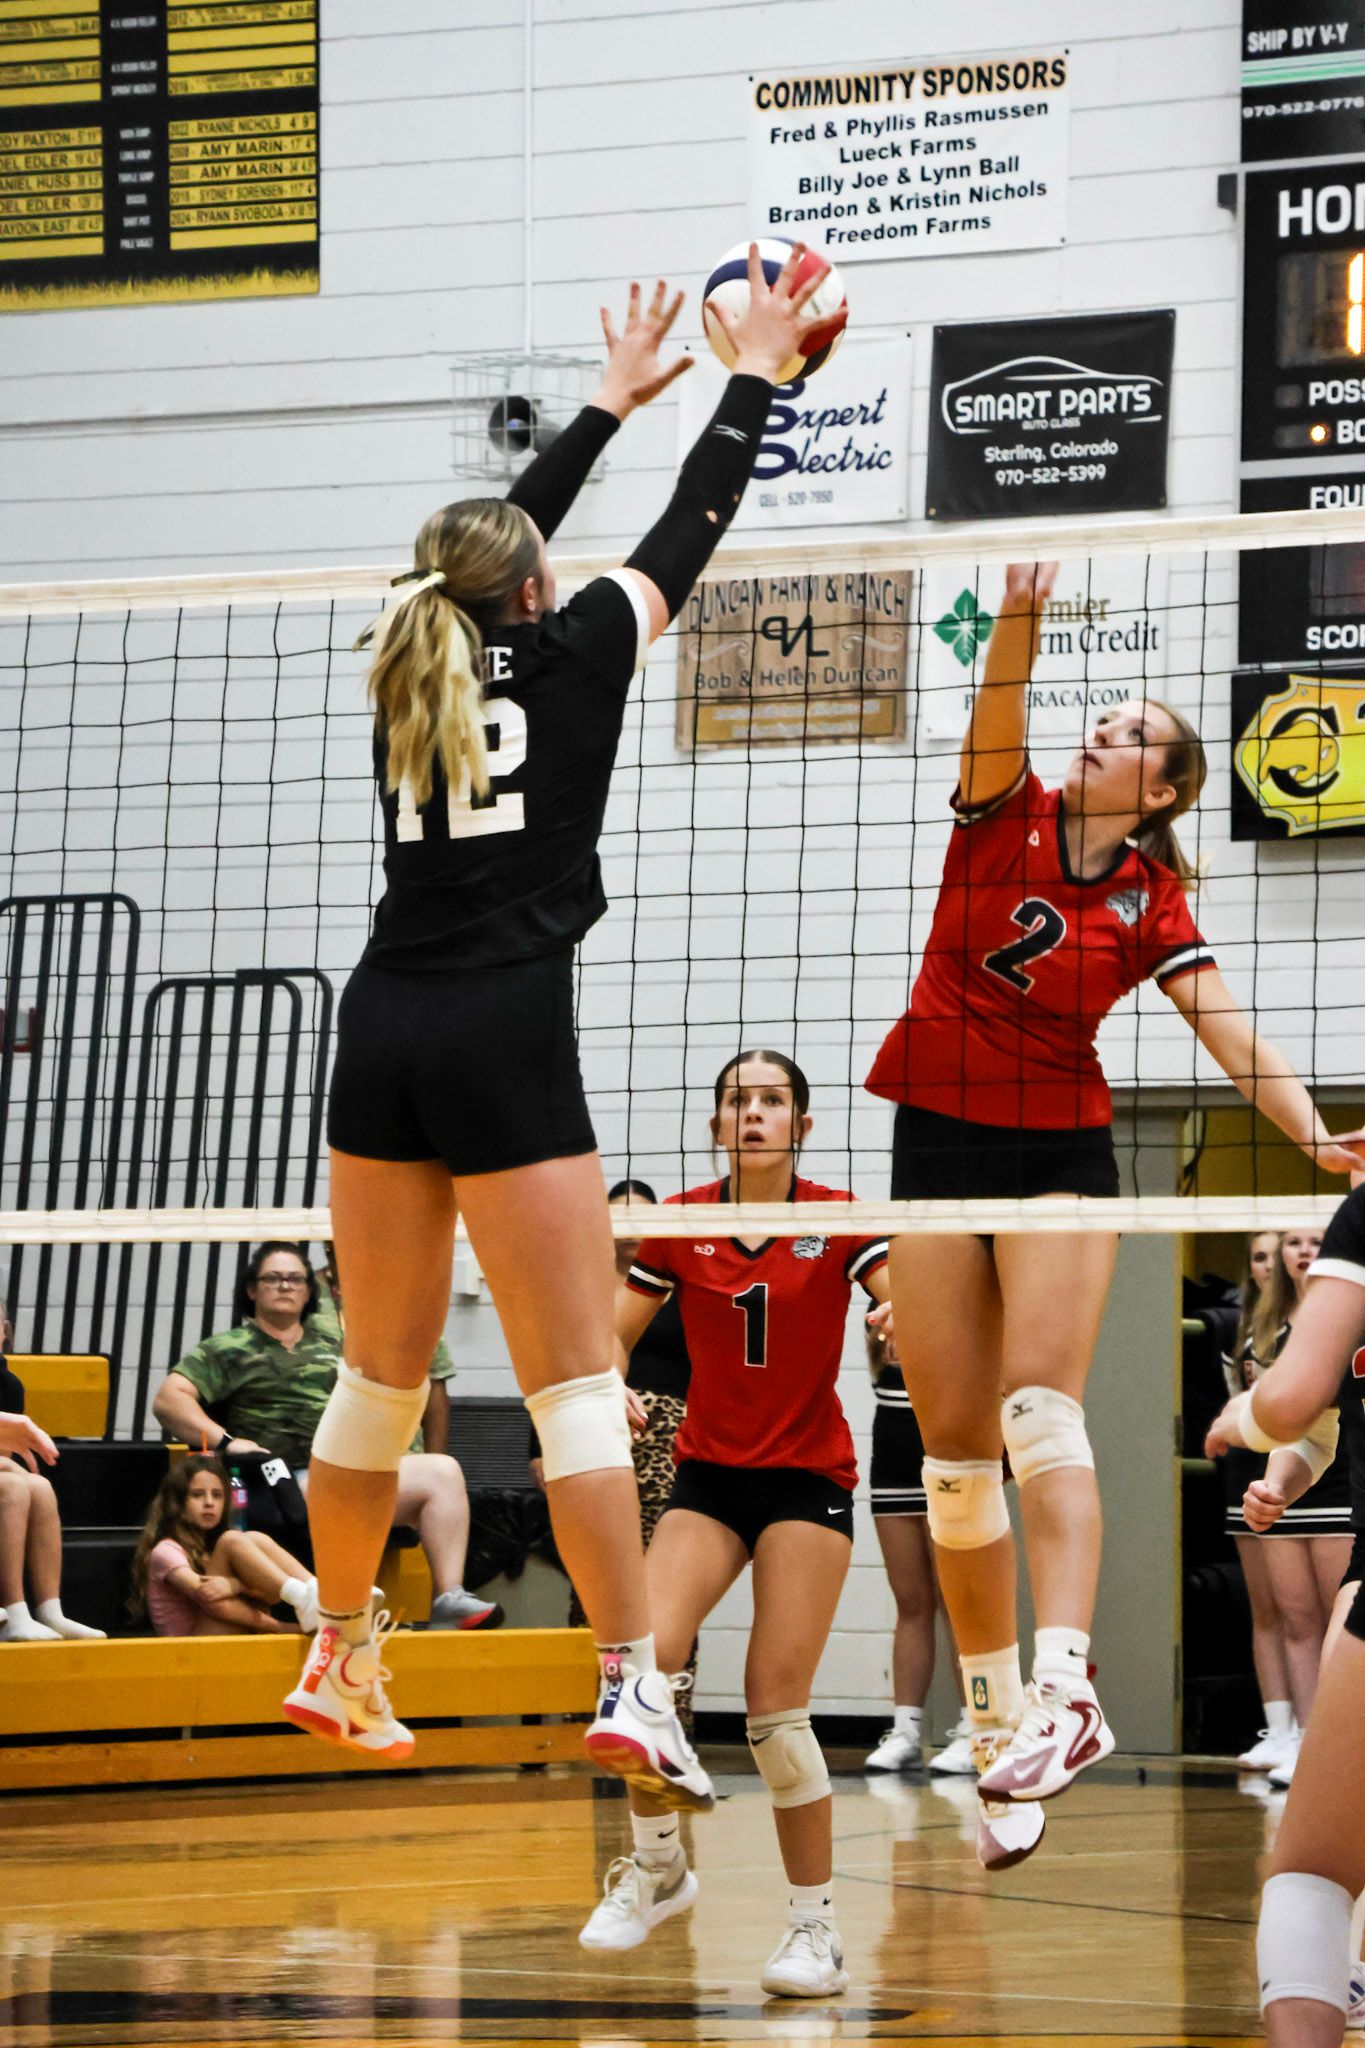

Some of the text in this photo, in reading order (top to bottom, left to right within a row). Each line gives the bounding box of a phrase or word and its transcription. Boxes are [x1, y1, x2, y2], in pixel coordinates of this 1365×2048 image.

[1292, 26, 1316, 49] BY
[755, 58, 1067, 110] COMMUNITY SPONSORS
[770, 102, 1049, 145] Fred & Phyllis Rasmussen
[200, 143, 232, 157] AMY
[839, 134, 977, 164] Lueck Farms
[200, 165, 232, 179] AMY
[798, 156, 1020, 196] Billy Joe & Lynn Ball
[769, 179, 1048, 224] Brandon & Kristin Nichols
[825, 213, 991, 245] Freedom Farms
[955, 383, 1152, 424] SMART PARTS
[1309, 378, 1365, 406] POS
[1022, 416, 1081, 430] AUTO GLASS
[1050, 438, 1119, 460] Colorado
[995, 463, 1106, 486] 970-522-5399
[1310, 484, 1365, 509] FOU
[689, 573, 908, 631] DUNCAN FARM & RANCH
[1043, 592, 1111, 624] mier
[1039, 621, 1160, 655] rm Credit
[1306, 624, 1365, 651] SCO
[696, 665, 899, 691] Bob & Helen Duncan
[982, 896, 1067, 995] 2
[732, 1283, 769, 1369] 1
